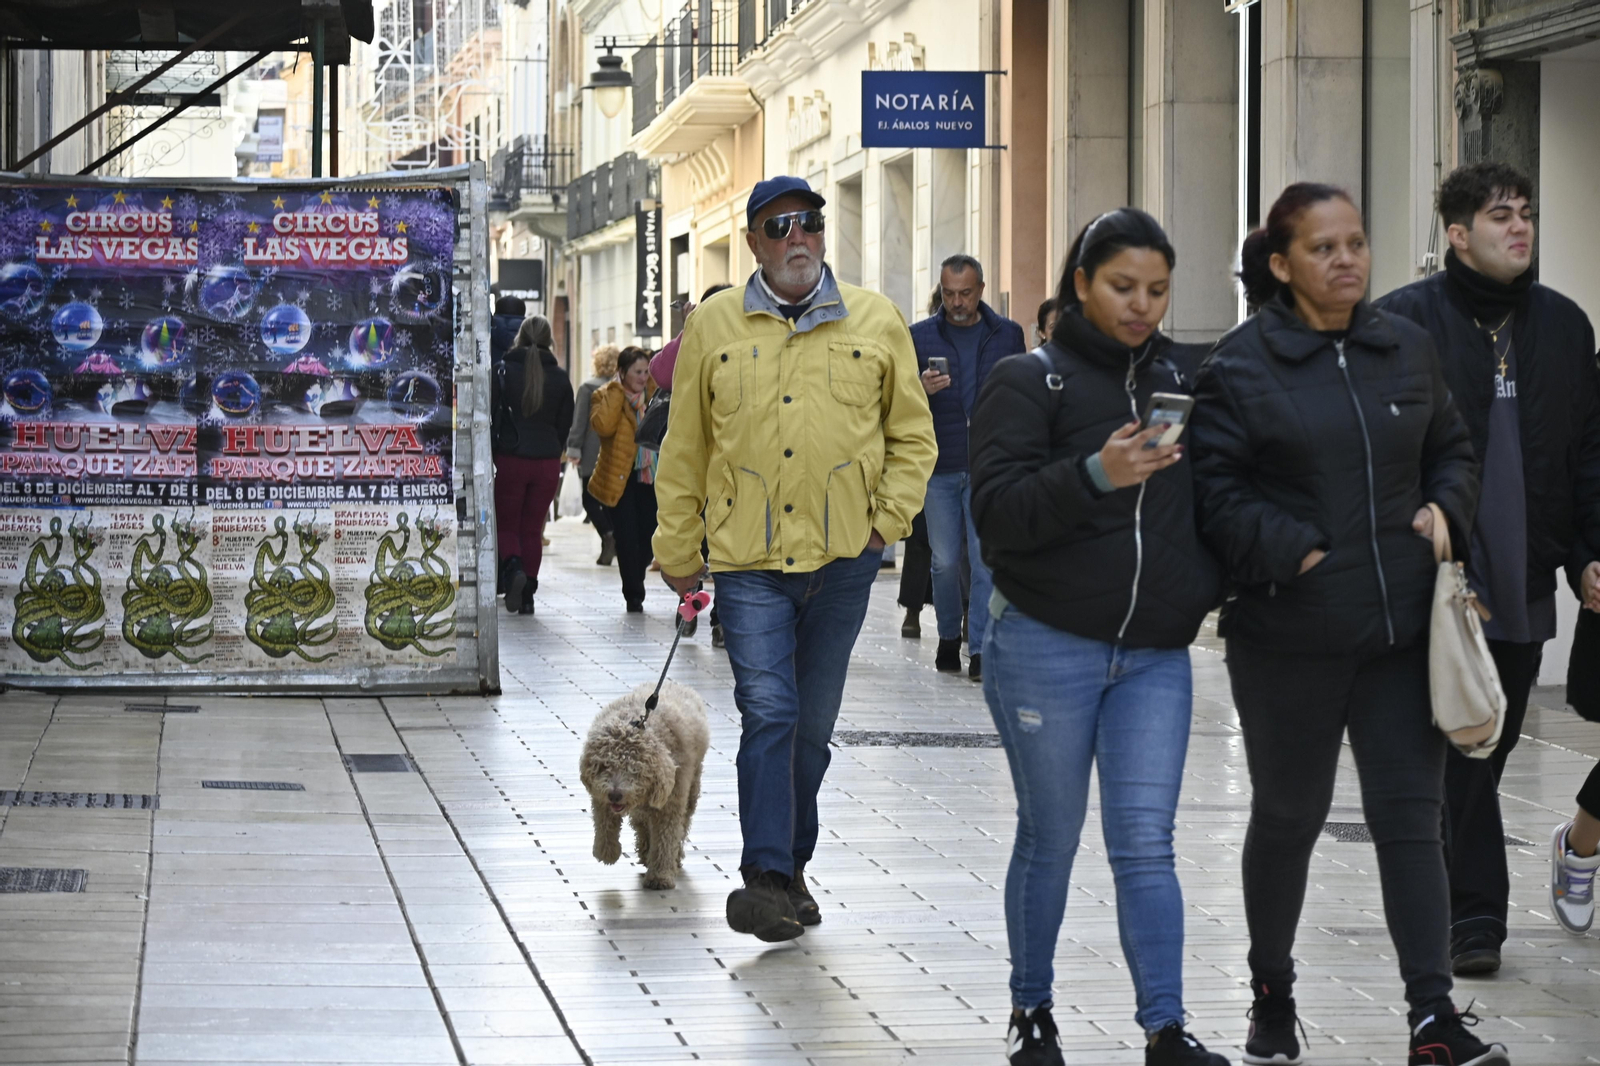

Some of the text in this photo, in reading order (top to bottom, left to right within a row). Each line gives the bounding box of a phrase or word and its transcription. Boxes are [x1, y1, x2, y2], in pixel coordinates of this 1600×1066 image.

[875, 90, 975, 111] NOTARÍA
[892, 119, 930, 130] ÁBALOS
[935, 121, 973, 130] NUEVO
[66, 212, 173, 235] CIRCUS
[273, 213, 380, 236] CIRCUS
[645, 211, 656, 252] VIAJES
[36, 236, 198, 262] LAS VEGAS
[243, 237, 409, 264] LAS VEGAS
[222, 424, 425, 454] HUELVA
[0, 452, 125, 478] PARQUE
[211, 455, 444, 482] PARQUE ZAFRA
[0, 482, 20, 493] EL
[24, 483, 31, 494] 8
[36, 483, 54, 495] DE
[58, 482, 134, 496] DICIEMBRE
[137, 484, 155, 496] AL
[158, 484, 166, 496] 7
[170, 484, 189, 497] DE
[206, 483, 448, 500] DEL 8 DE DICIEMBRE AL 7 DE ENERO
[212, 516, 267, 524] GRAFISTAS
[212, 524, 267, 533] ONUBENSES
[334, 519, 389, 527] ONUBENSES
